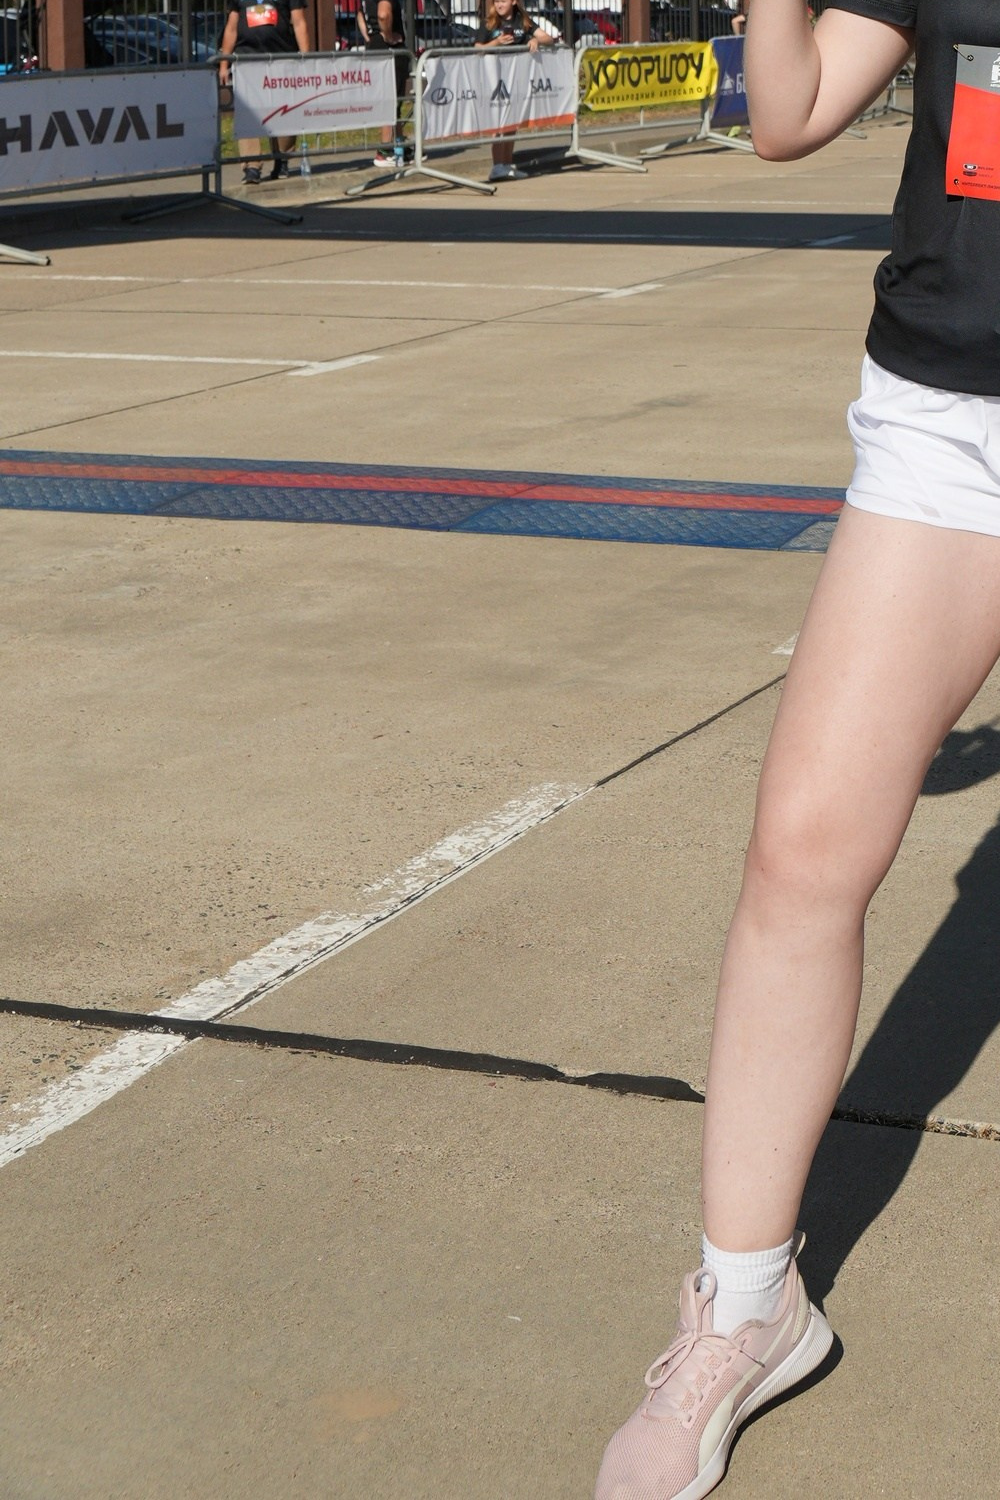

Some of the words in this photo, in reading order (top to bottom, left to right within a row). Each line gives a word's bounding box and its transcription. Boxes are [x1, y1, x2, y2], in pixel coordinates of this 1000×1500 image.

[263, 75, 321, 90] Автоцентр
[325, 74, 338, 85] на
[341, 69, 371, 86] МКАД
[0, 103, 184, 156] HAVAL
